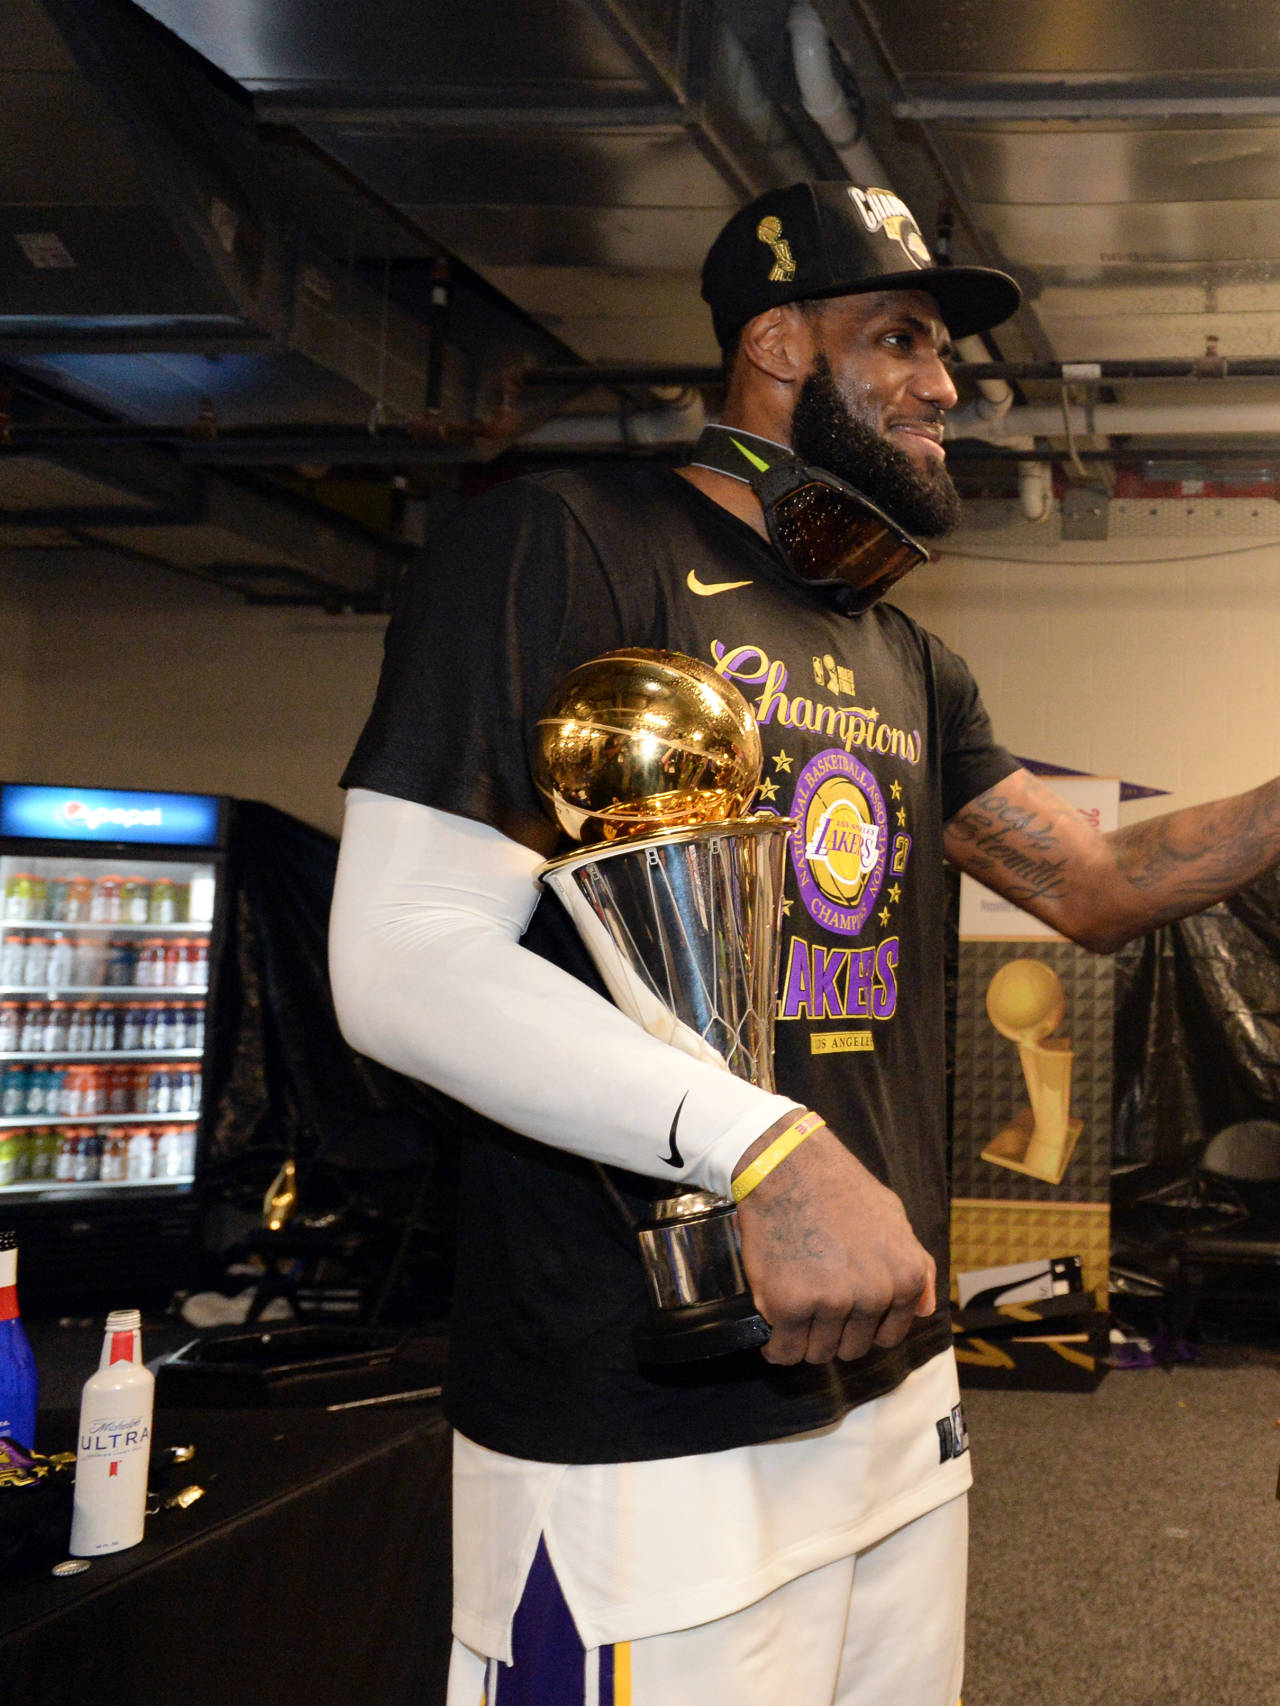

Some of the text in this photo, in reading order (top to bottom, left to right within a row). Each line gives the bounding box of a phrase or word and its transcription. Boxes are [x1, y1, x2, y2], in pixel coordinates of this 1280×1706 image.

[710, 639, 922, 766] Champions
[804, 754, 868, 789] BASKETBALL
[831, 1036, 873, 1049] ANGELE
[81, 1427, 149, 1451] ULTRA
